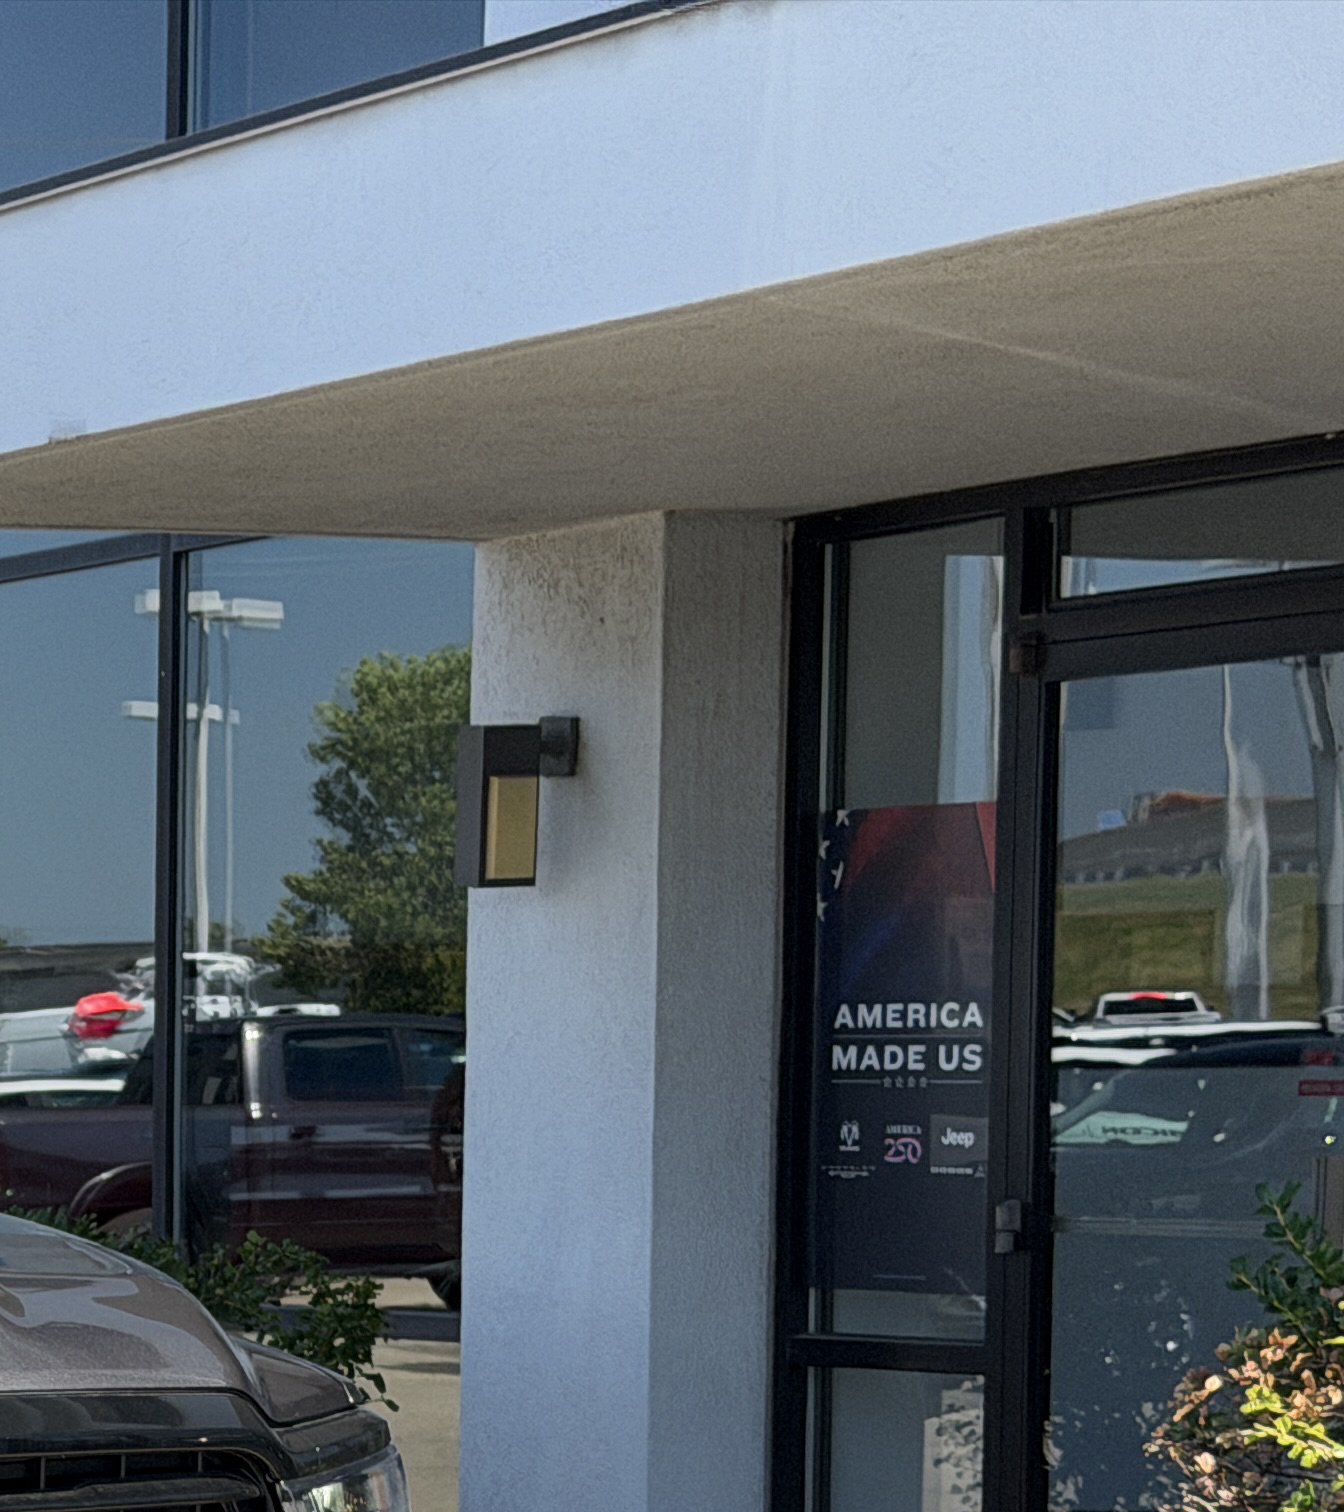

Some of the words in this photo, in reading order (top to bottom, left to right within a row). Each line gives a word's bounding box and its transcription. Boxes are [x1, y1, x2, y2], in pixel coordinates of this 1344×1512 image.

[834, 1002, 984, 1029] AMERICA
[831, 1044, 927, 1071] MADE
[938, 1043, 983, 1072] US
[883, 1137, 922, 1164] 250
[941, 1127, 975, 1148] Jeep
